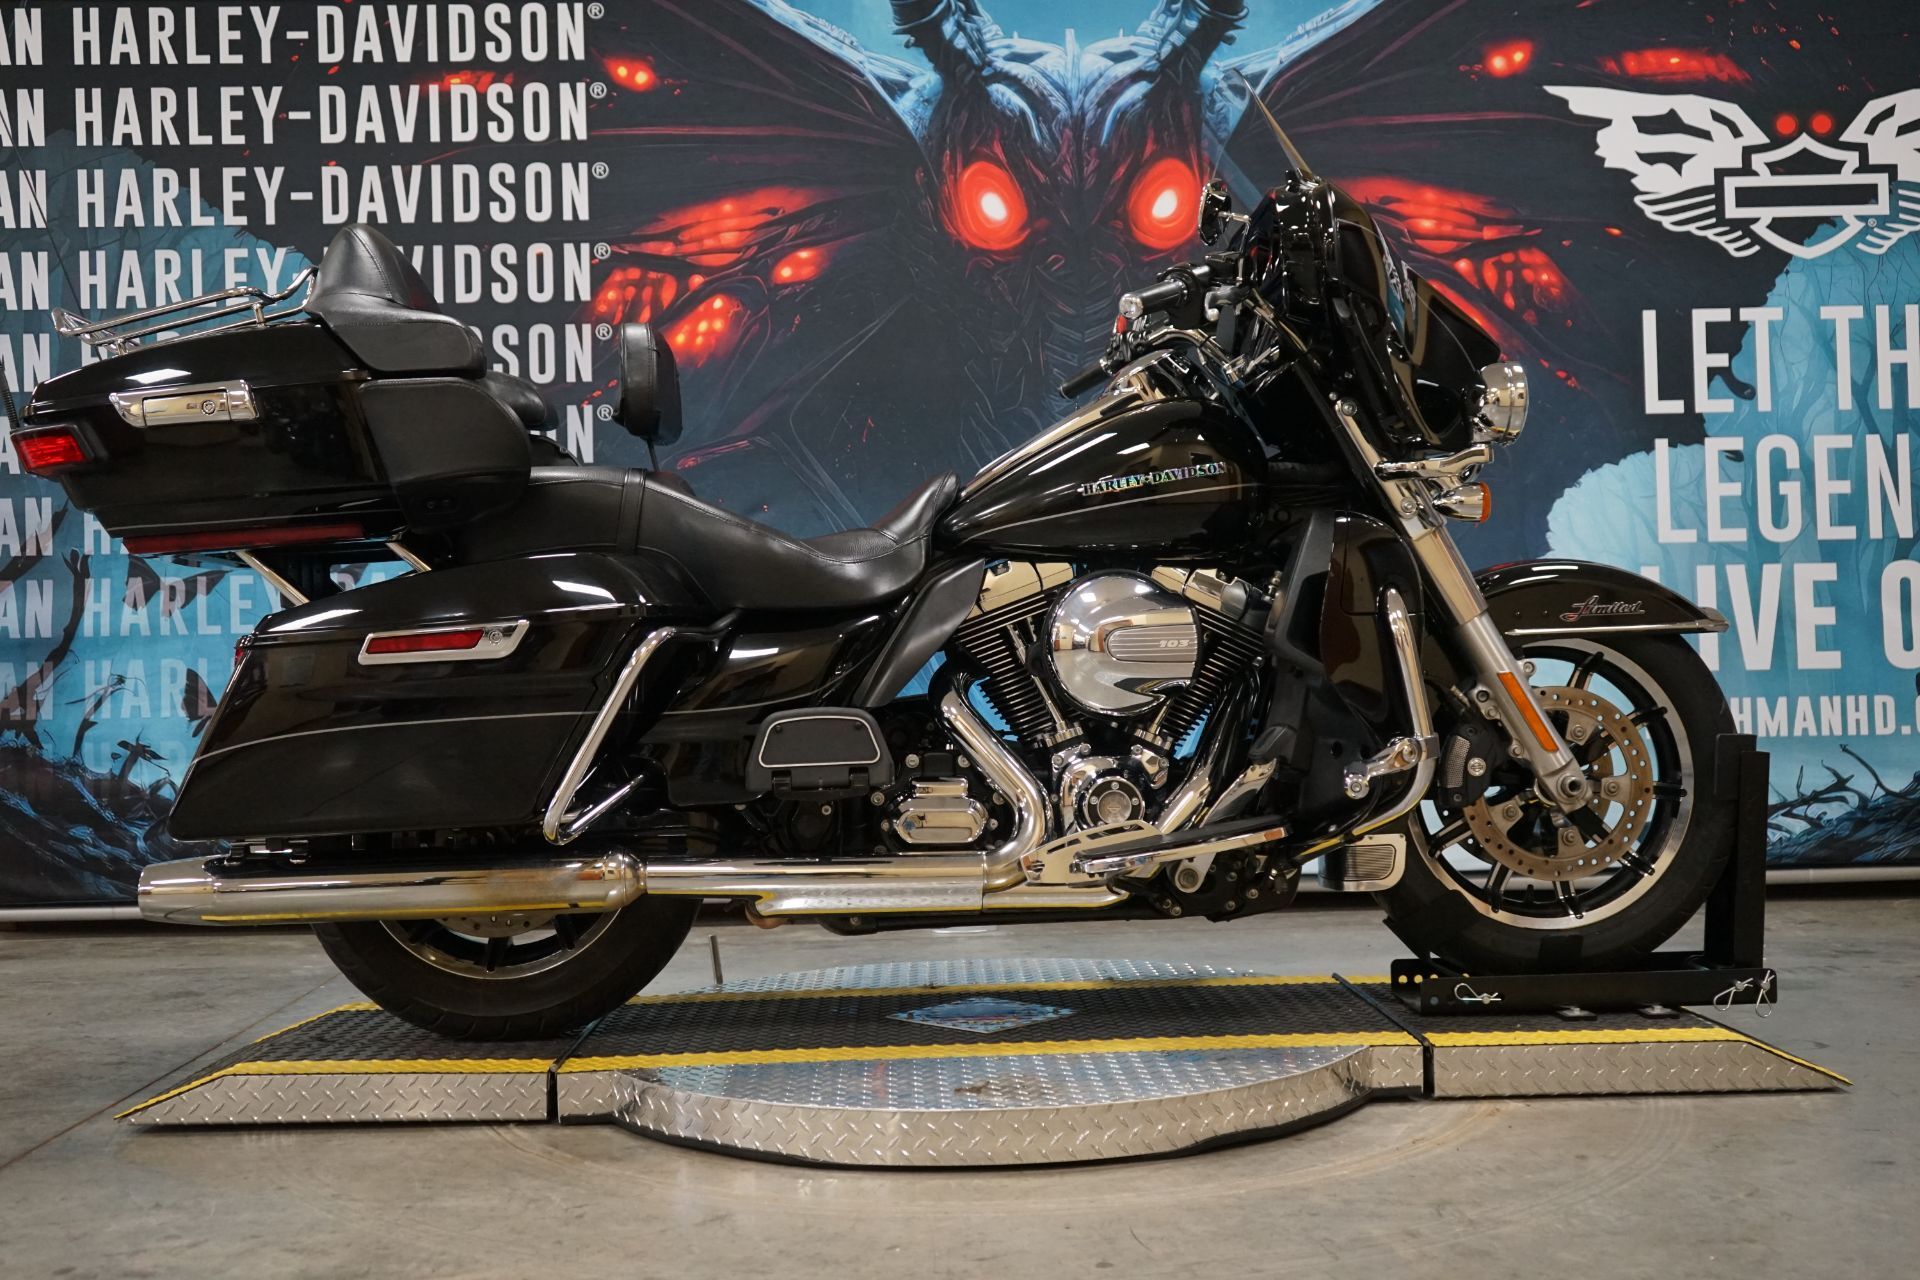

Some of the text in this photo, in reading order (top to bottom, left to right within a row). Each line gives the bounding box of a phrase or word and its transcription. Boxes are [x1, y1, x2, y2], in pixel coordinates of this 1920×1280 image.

[1642, 304, 1920, 415] LET TH
[1655, 433, 1914, 544] LEGEN
[1160, 640, 1190, 648] 103
[1641, 562, 1842, 672] IVE
